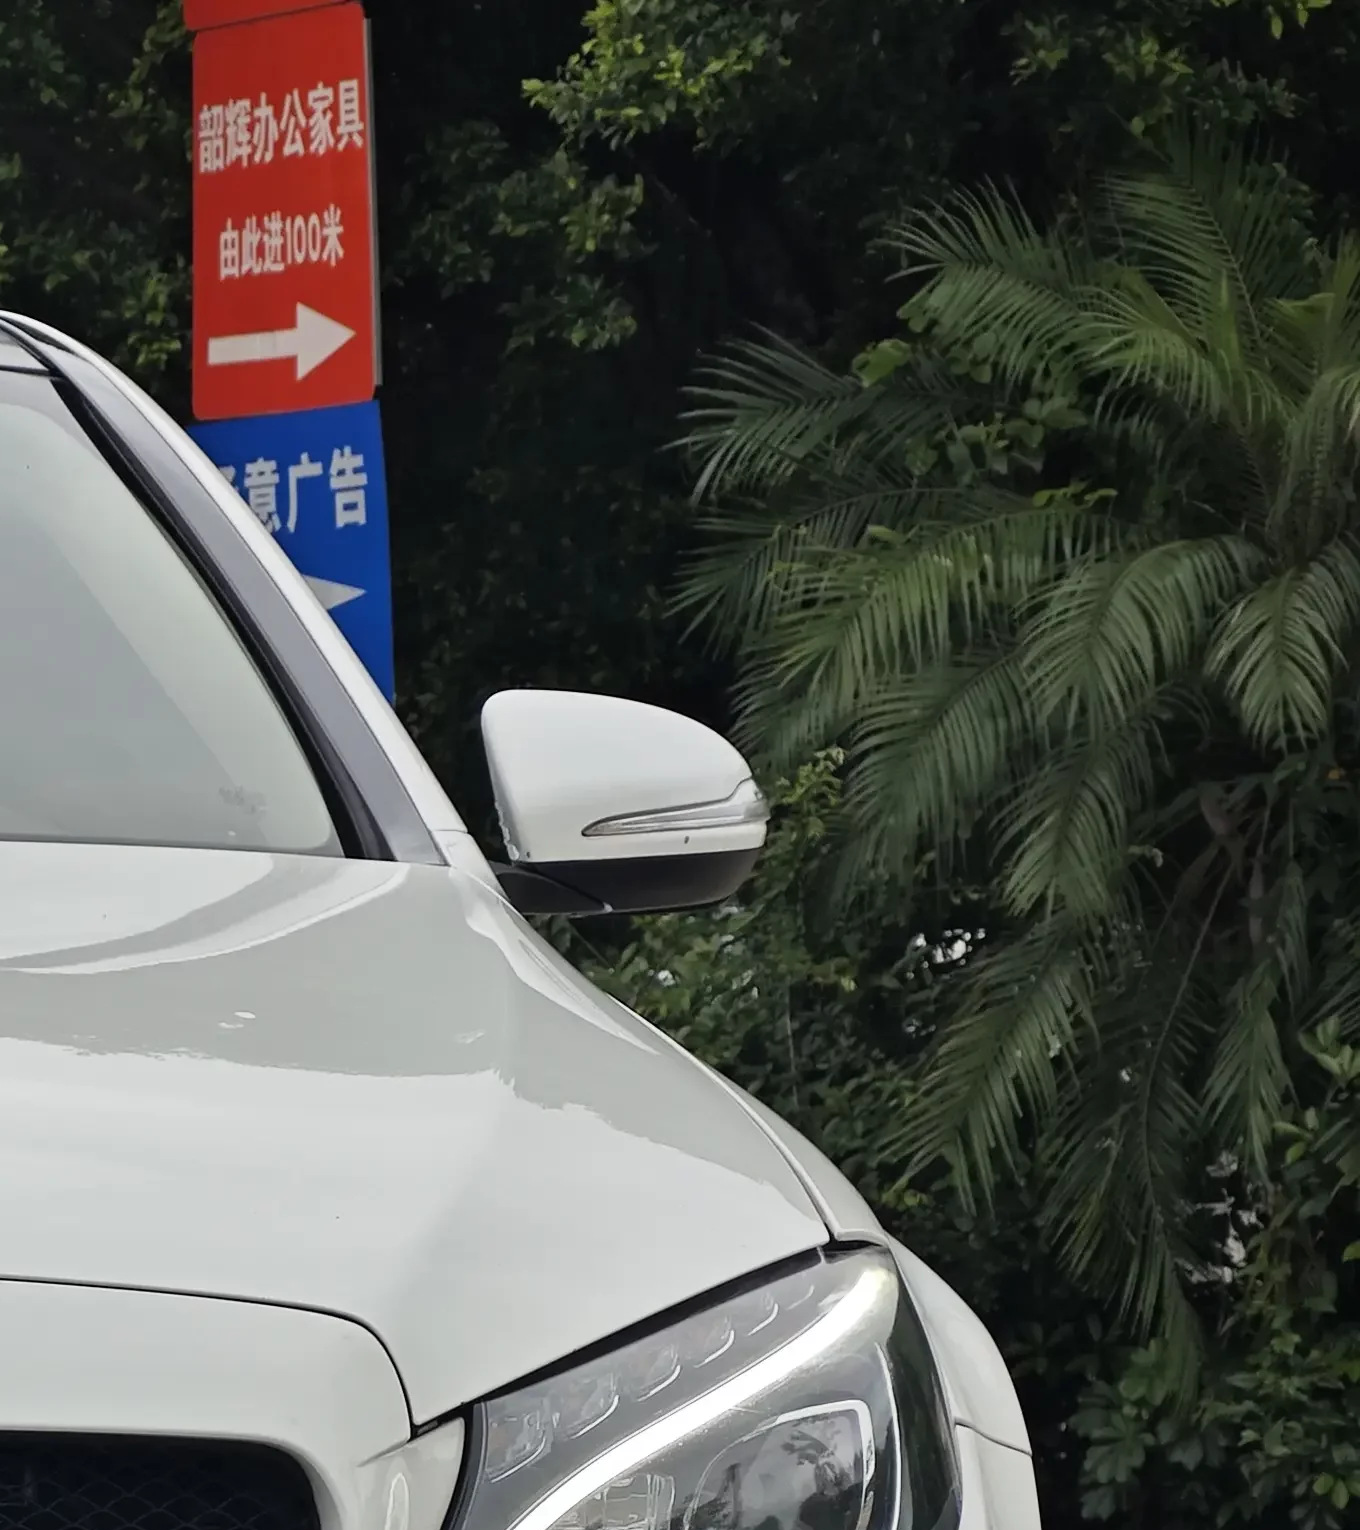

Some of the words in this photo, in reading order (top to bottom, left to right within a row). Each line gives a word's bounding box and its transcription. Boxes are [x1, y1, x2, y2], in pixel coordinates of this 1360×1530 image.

[198, 78, 364, 173] 韶辉办公家具
[219, 204, 345, 281] 由此进100米
[218, 446, 368, 533] 意广告
